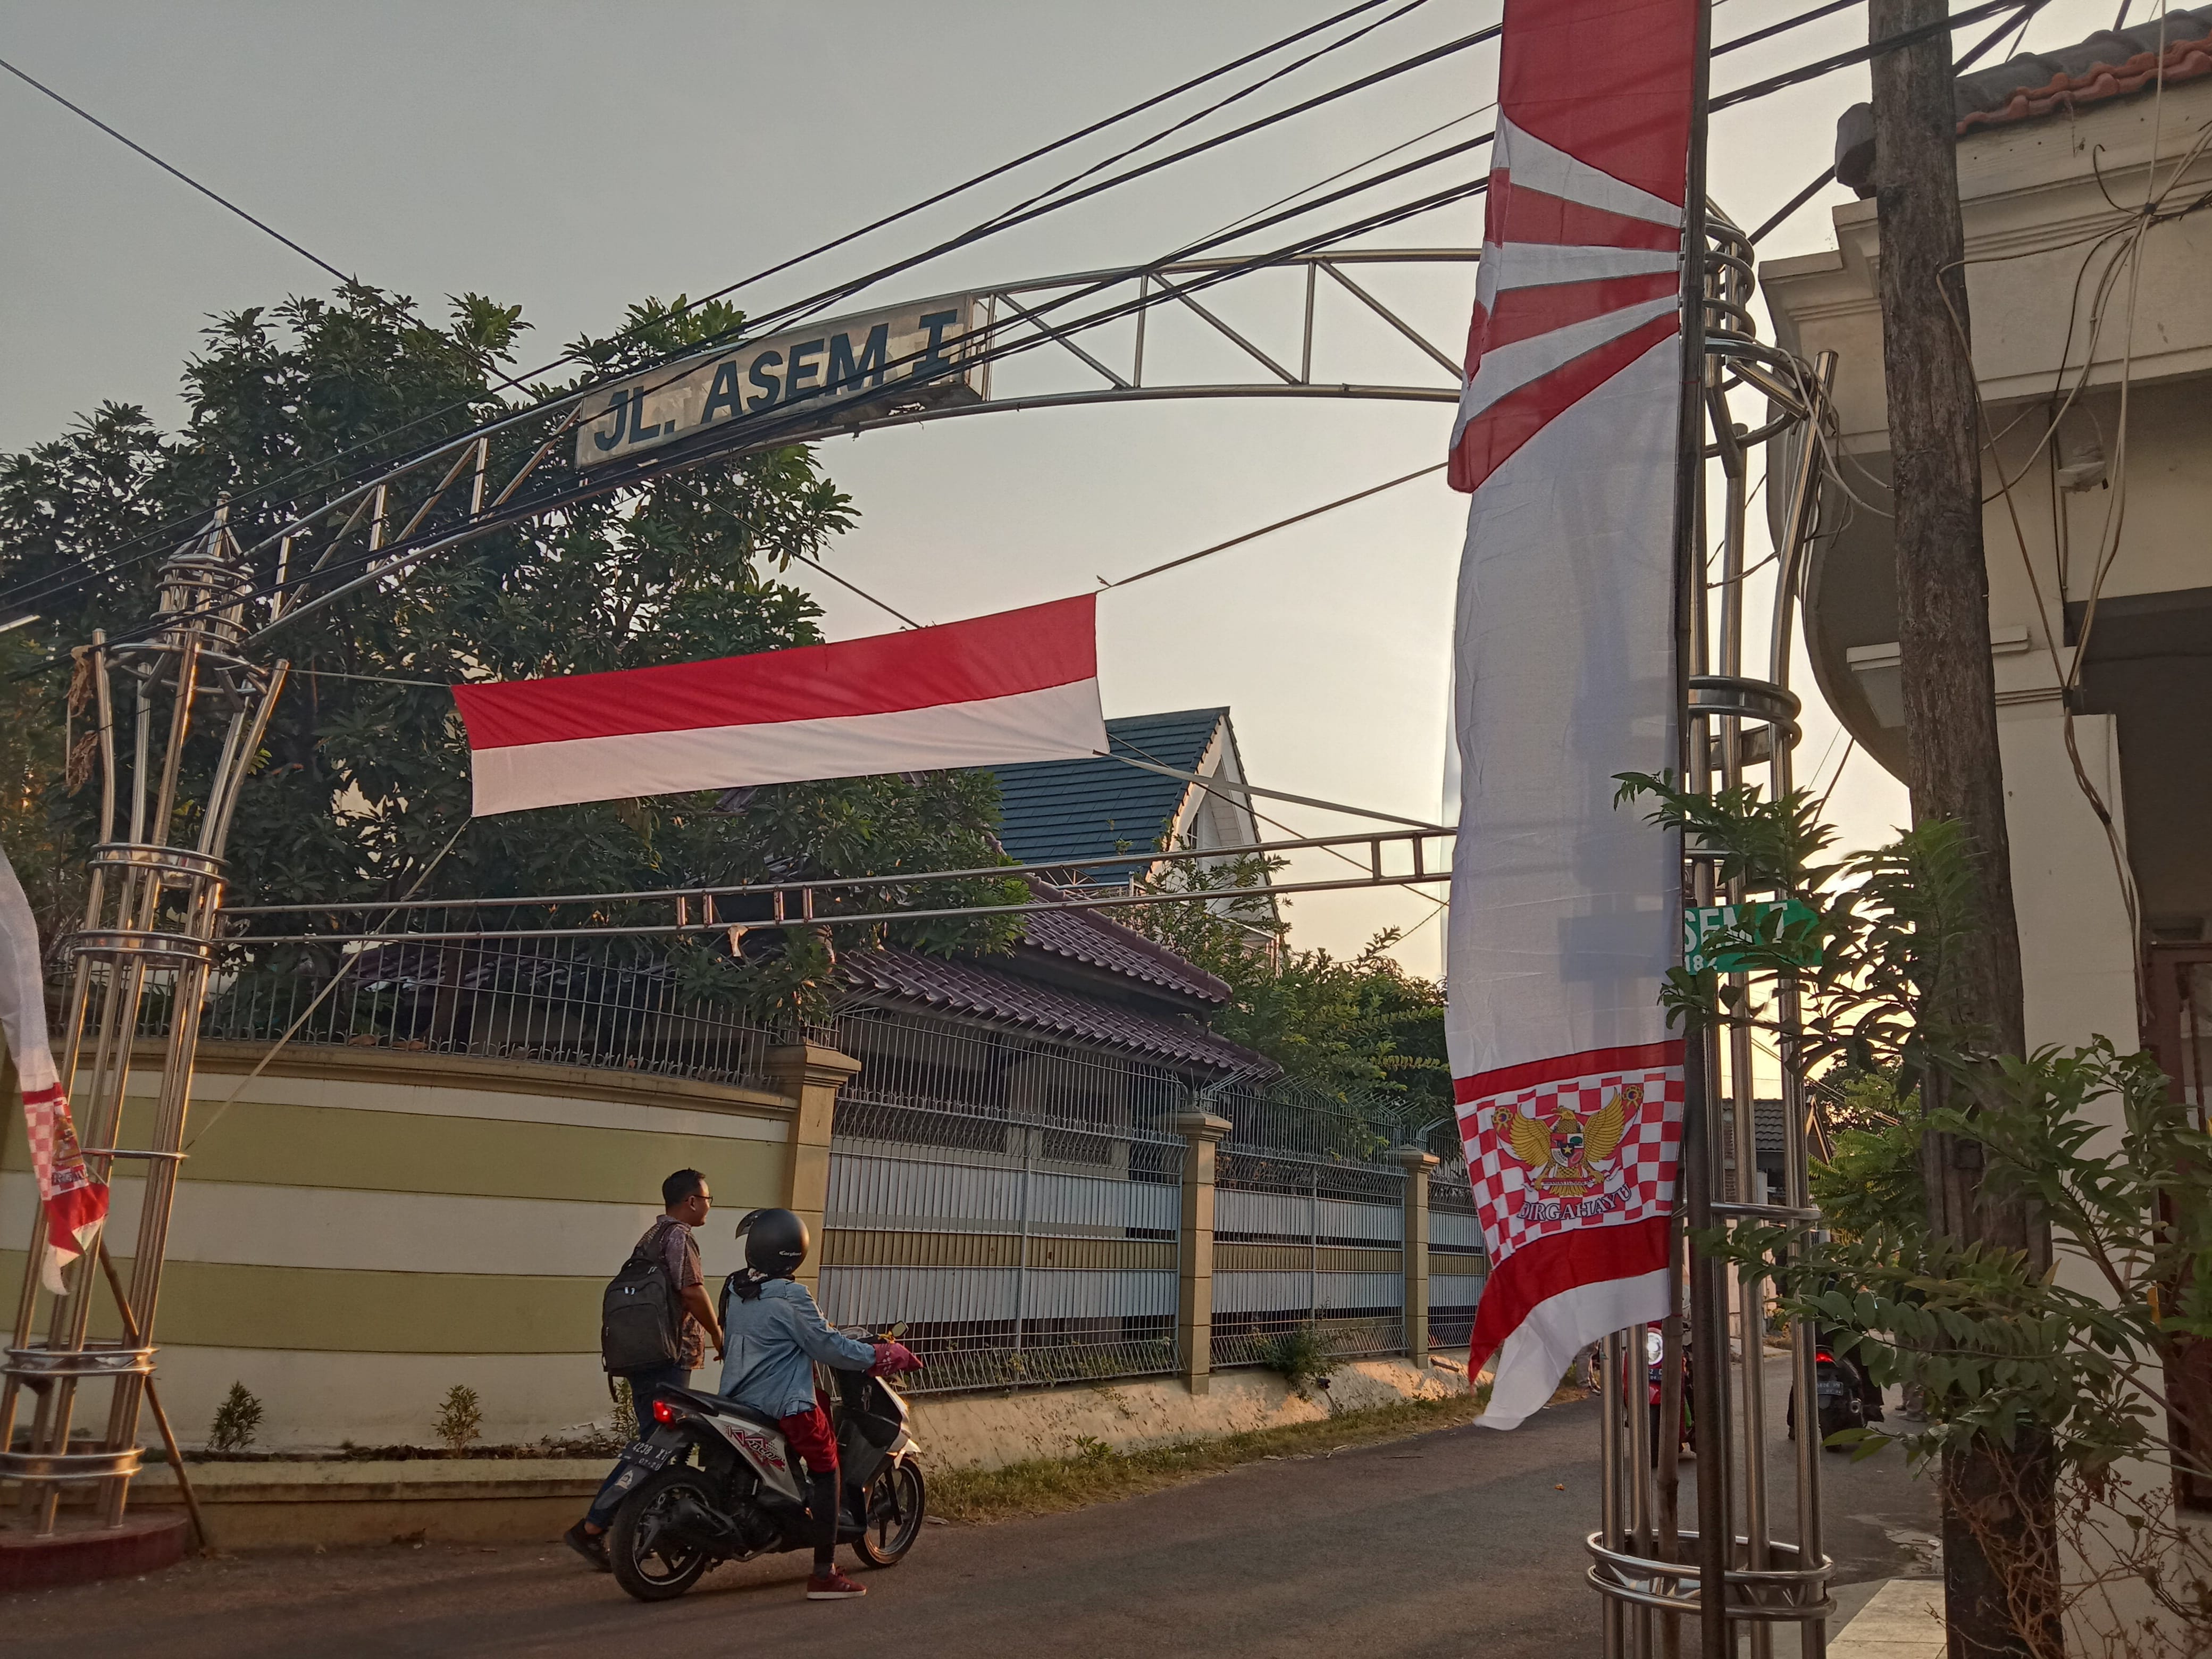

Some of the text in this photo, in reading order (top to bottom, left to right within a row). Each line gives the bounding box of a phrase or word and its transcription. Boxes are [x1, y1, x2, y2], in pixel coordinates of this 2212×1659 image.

[594, 384, 676, 451] JL.
[700, 323, 889, 424] ASEM
[1517, 1183, 1632, 1221] DIRGAHAYU
[632, 1442, 653, 1455] 4238
